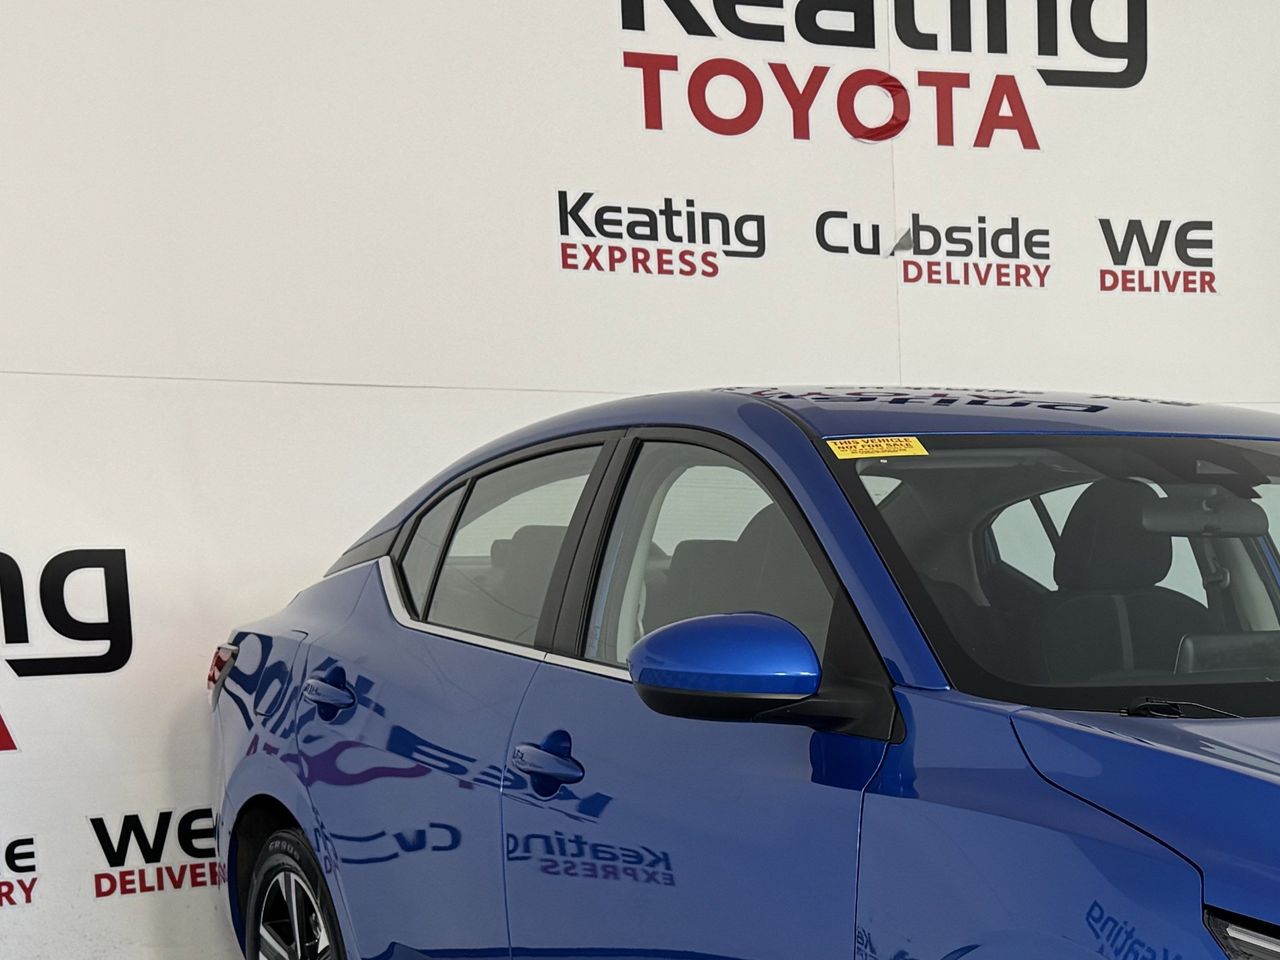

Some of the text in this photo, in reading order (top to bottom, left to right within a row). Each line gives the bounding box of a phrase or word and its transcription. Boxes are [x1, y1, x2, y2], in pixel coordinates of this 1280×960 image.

[623, 51, 1041, 150] TOYOTA
[558, 190, 766, 258] Keating
[815, 210, 1050, 260] Cubside
[1098, 218, 1213, 267] WE
[561, 242, 719, 278] EXPRESS
[902, 260, 1051, 288] DELIVERY
[1100, 269, 1217, 293] DELIVER
[90, 808, 217, 868] WE
